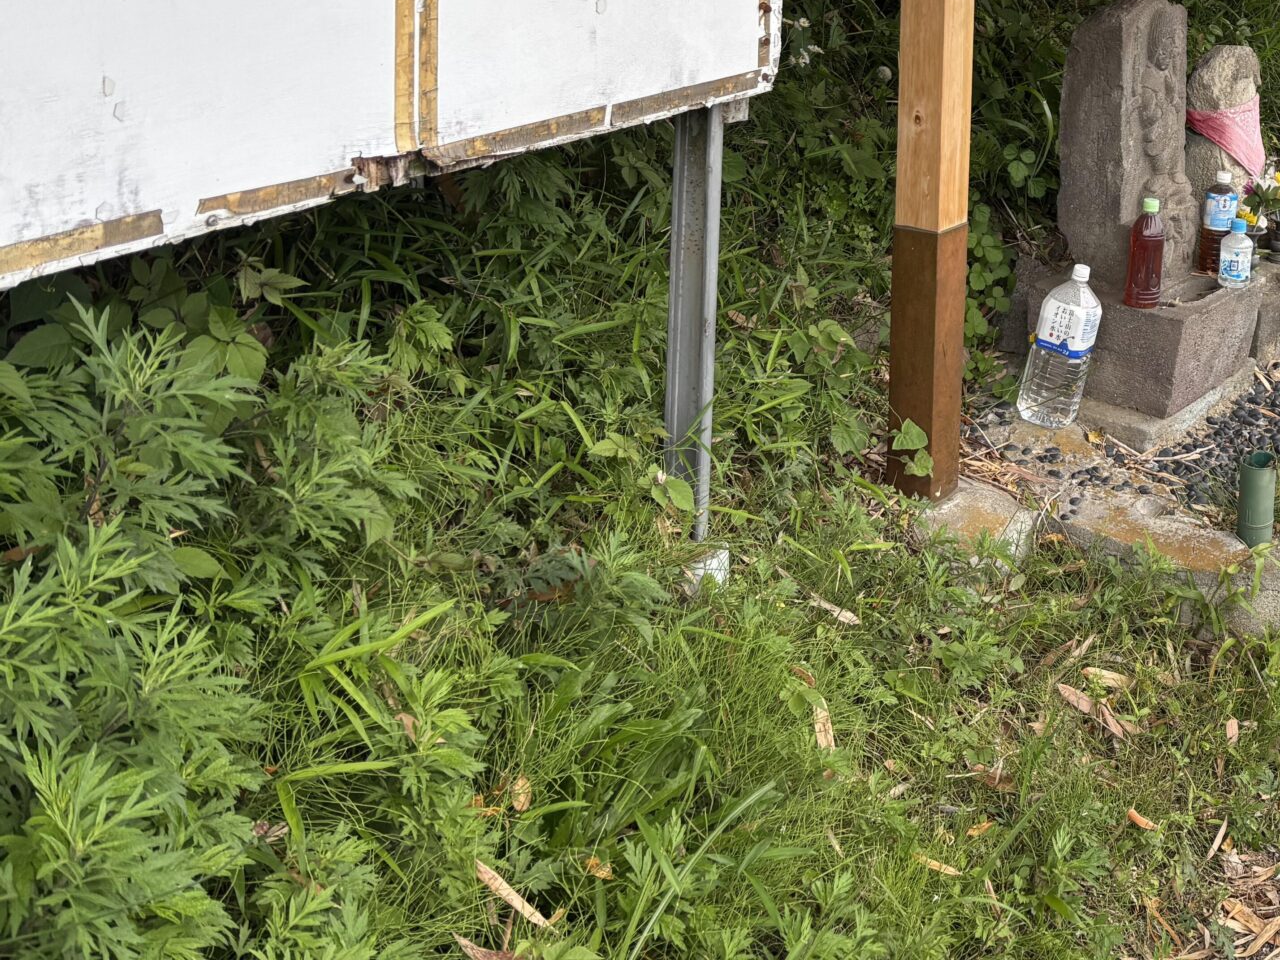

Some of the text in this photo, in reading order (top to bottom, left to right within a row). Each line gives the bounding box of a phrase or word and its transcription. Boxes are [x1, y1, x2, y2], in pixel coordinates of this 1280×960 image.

[1055, 308, 1067, 341] おいしい水
